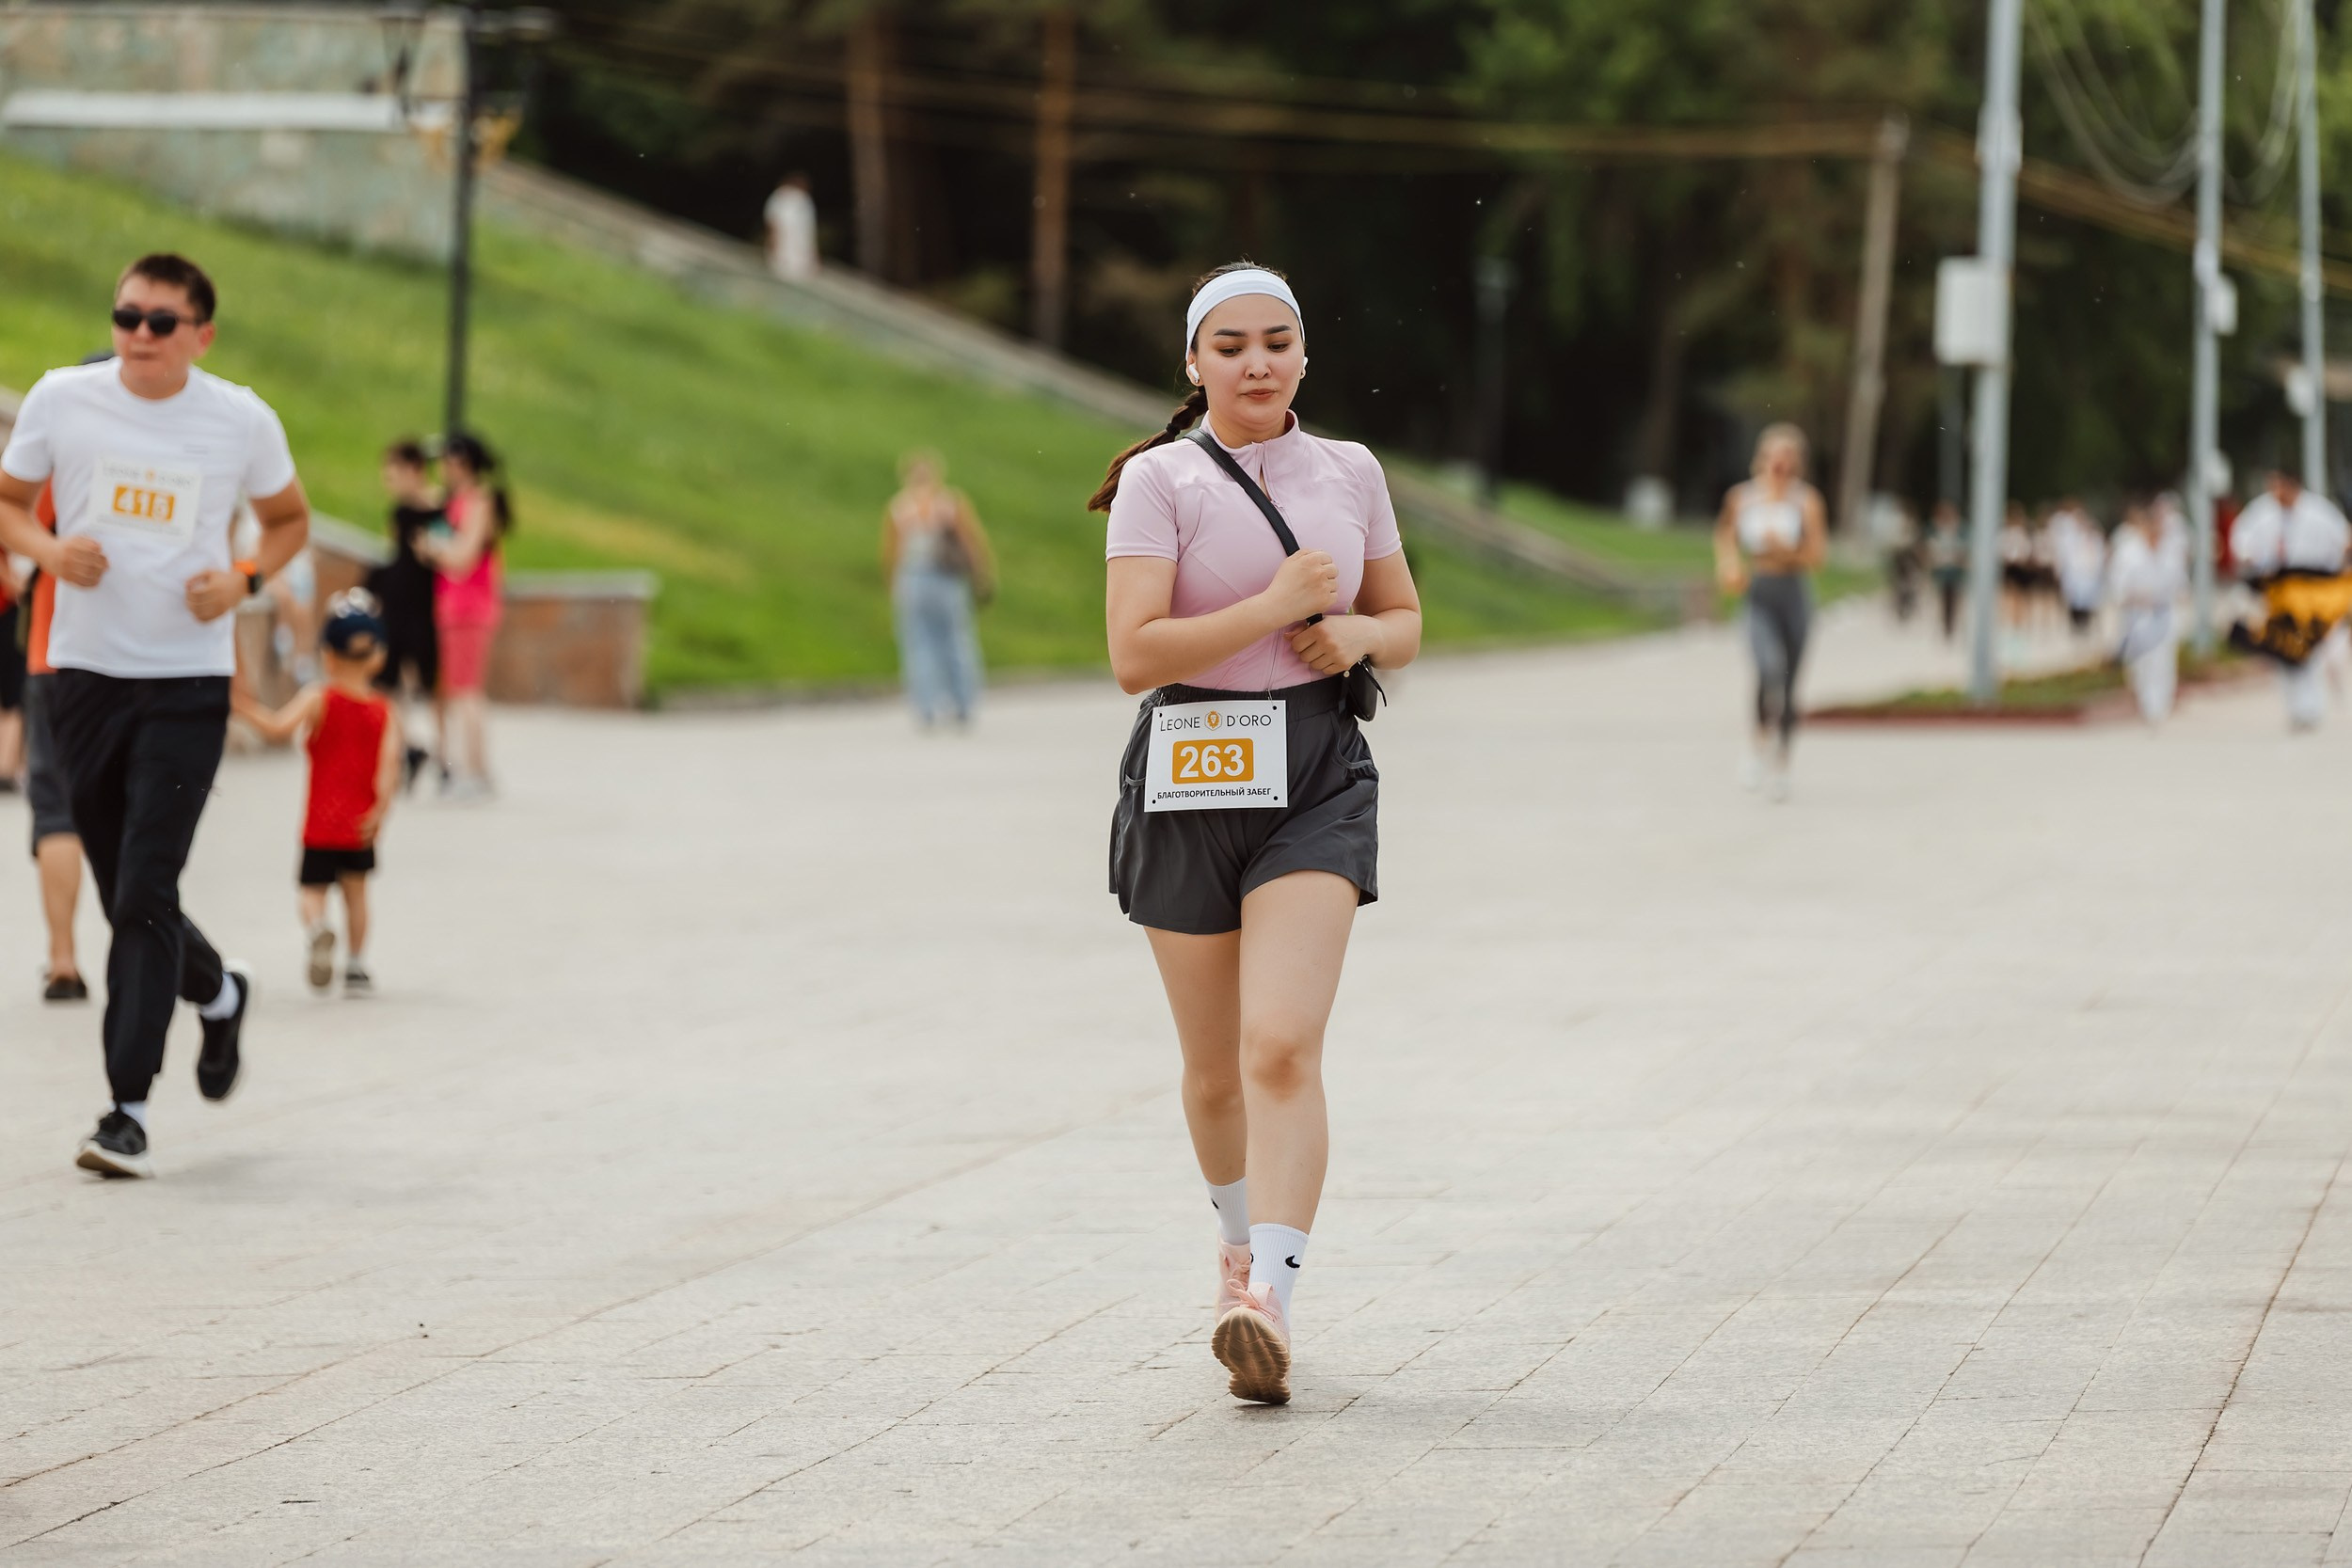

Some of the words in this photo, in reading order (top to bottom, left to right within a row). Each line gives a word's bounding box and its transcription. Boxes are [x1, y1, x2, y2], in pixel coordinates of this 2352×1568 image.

[1160, 717, 1200, 731] LEONE
[1227, 715, 1272, 727] D'ORO
[1179, 744, 1245, 778] 263
[1157, 787, 1245, 800] БЛАГОТВОРИТЕЛЬНЫЙ
[1247, 787, 1272, 796] ЗАБЕГ
